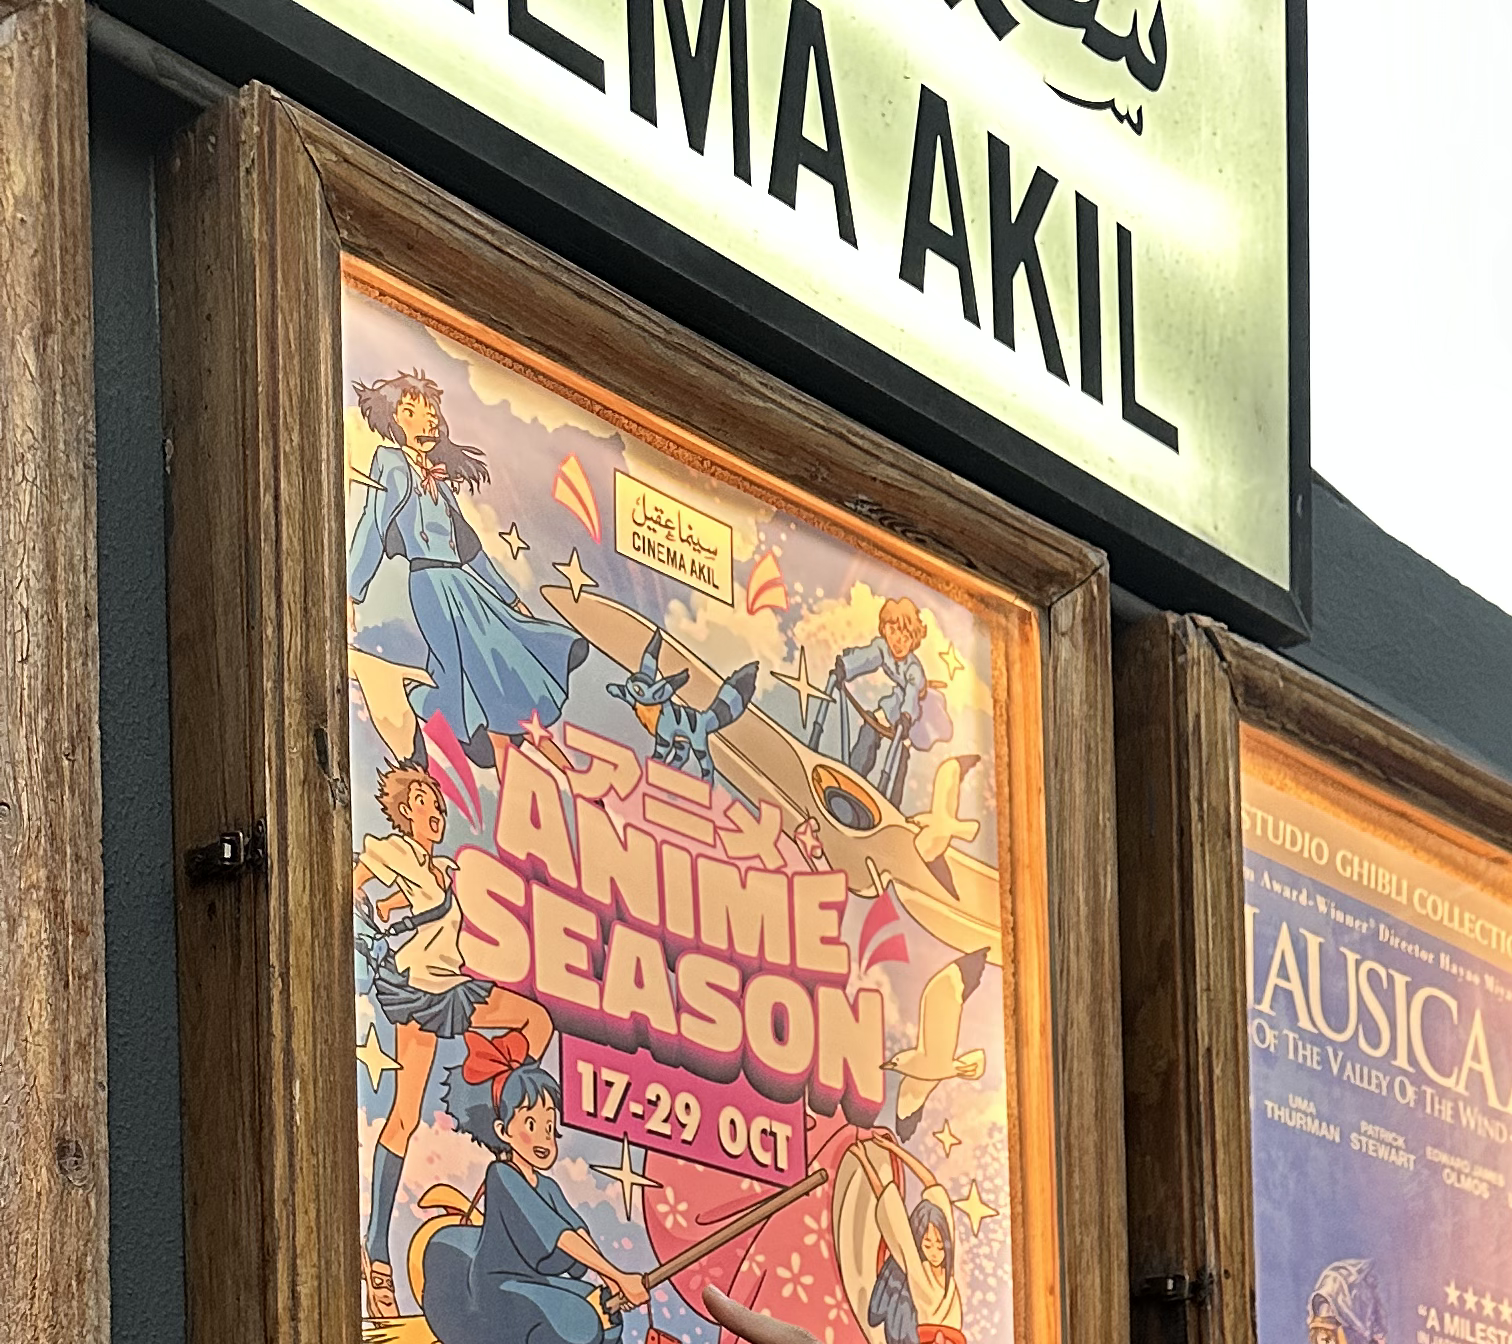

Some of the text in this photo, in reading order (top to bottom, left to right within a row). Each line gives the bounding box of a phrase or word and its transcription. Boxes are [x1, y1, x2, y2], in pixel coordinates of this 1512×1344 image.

[898, 83, 1180, 456] AKIL
[632, 531, 719, 590] CINEMA AKIL
[563, 722, 786, 871] アニメ
[495, 744, 850, 978] ANIME
[1335, 849, 1408, 905] GHIBLI
[1379, 922, 1435, 964] Director
[454, 844, 886, 1112] SEASON
[577, 1059, 793, 1171] 17-29 OCT
[1264, 1100, 1341, 1144] THURMAN
[1288, 1093, 1317, 1116] UMA
[1350, 1131, 1416, 1171] STEWART
[1360, 1119, 1406, 1149] PATRICK
[1442, 1168, 1490, 1199] OLMOS
